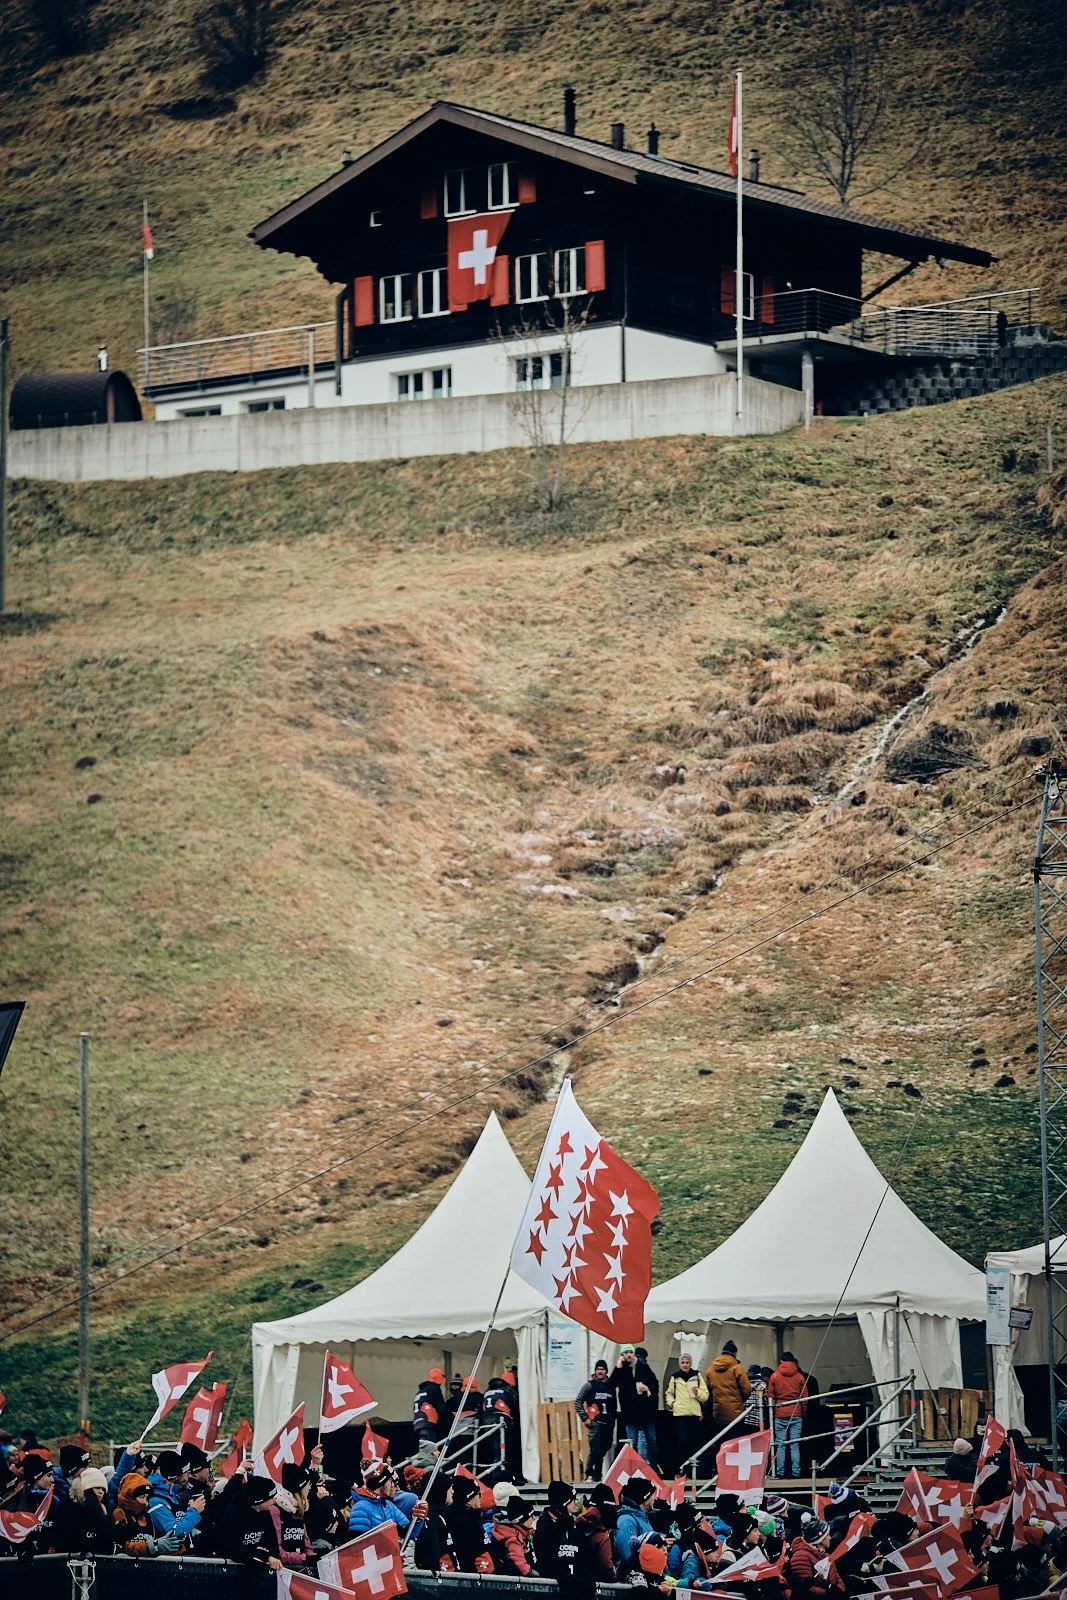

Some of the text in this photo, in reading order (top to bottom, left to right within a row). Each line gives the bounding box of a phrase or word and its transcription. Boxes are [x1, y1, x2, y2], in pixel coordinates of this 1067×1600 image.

[601, 1403, 607, 1415] 1
[283, 1533, 304, 1541] SPORT
[557, 1550, 575, 1558] SPORT
